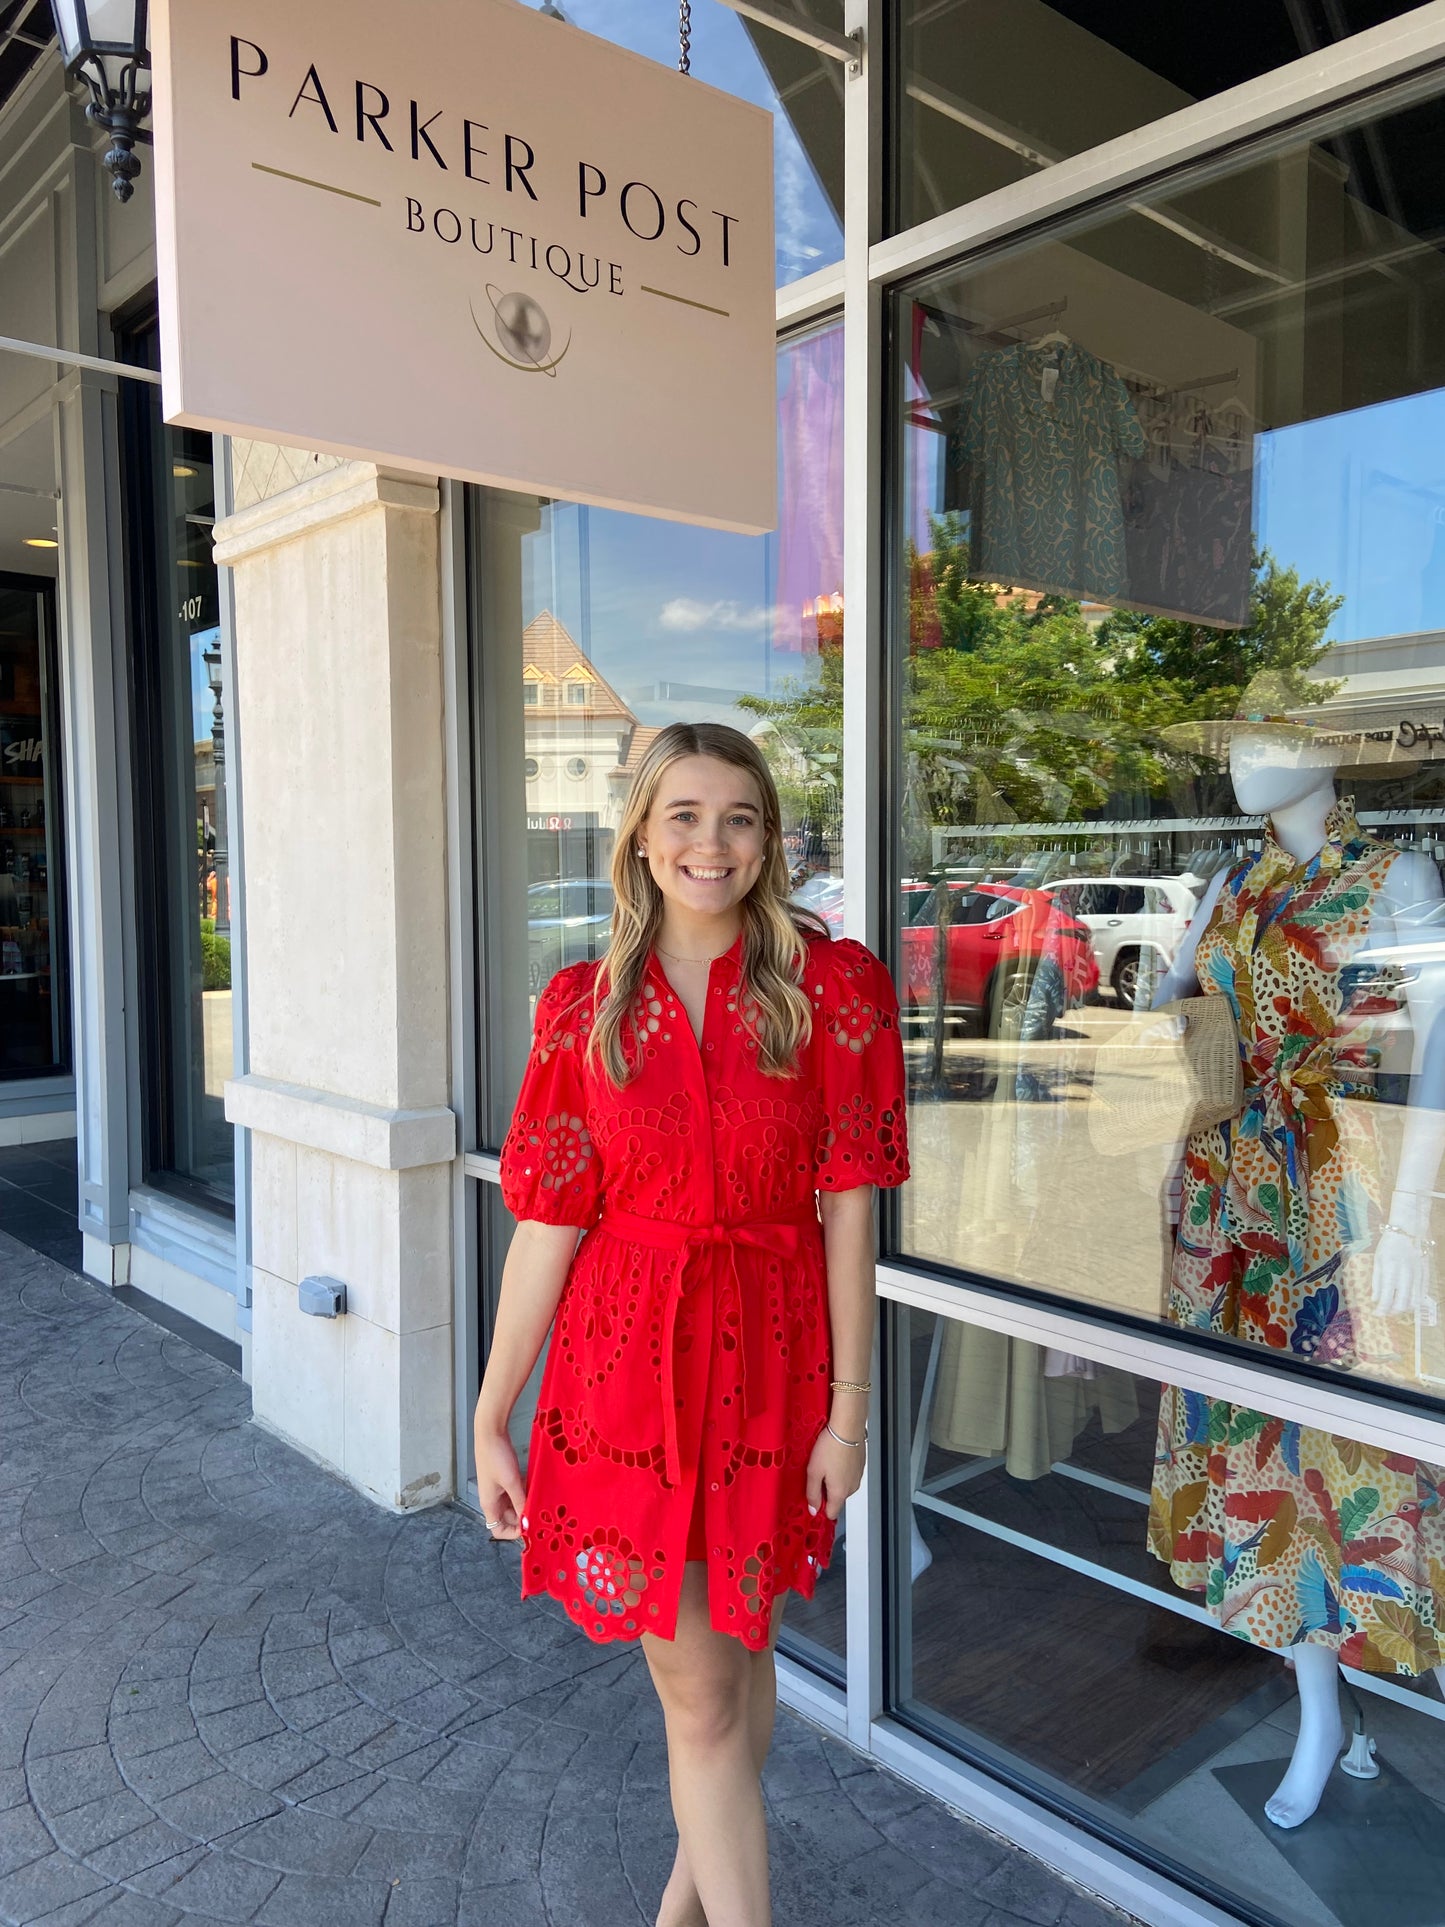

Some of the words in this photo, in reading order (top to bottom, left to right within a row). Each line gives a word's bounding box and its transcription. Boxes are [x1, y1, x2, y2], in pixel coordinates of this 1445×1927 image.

[229, 35, 539, 201] PARKER
[578, 161, 740, 267] POST
[405, 197, 625, 296] BOUTIQUE
